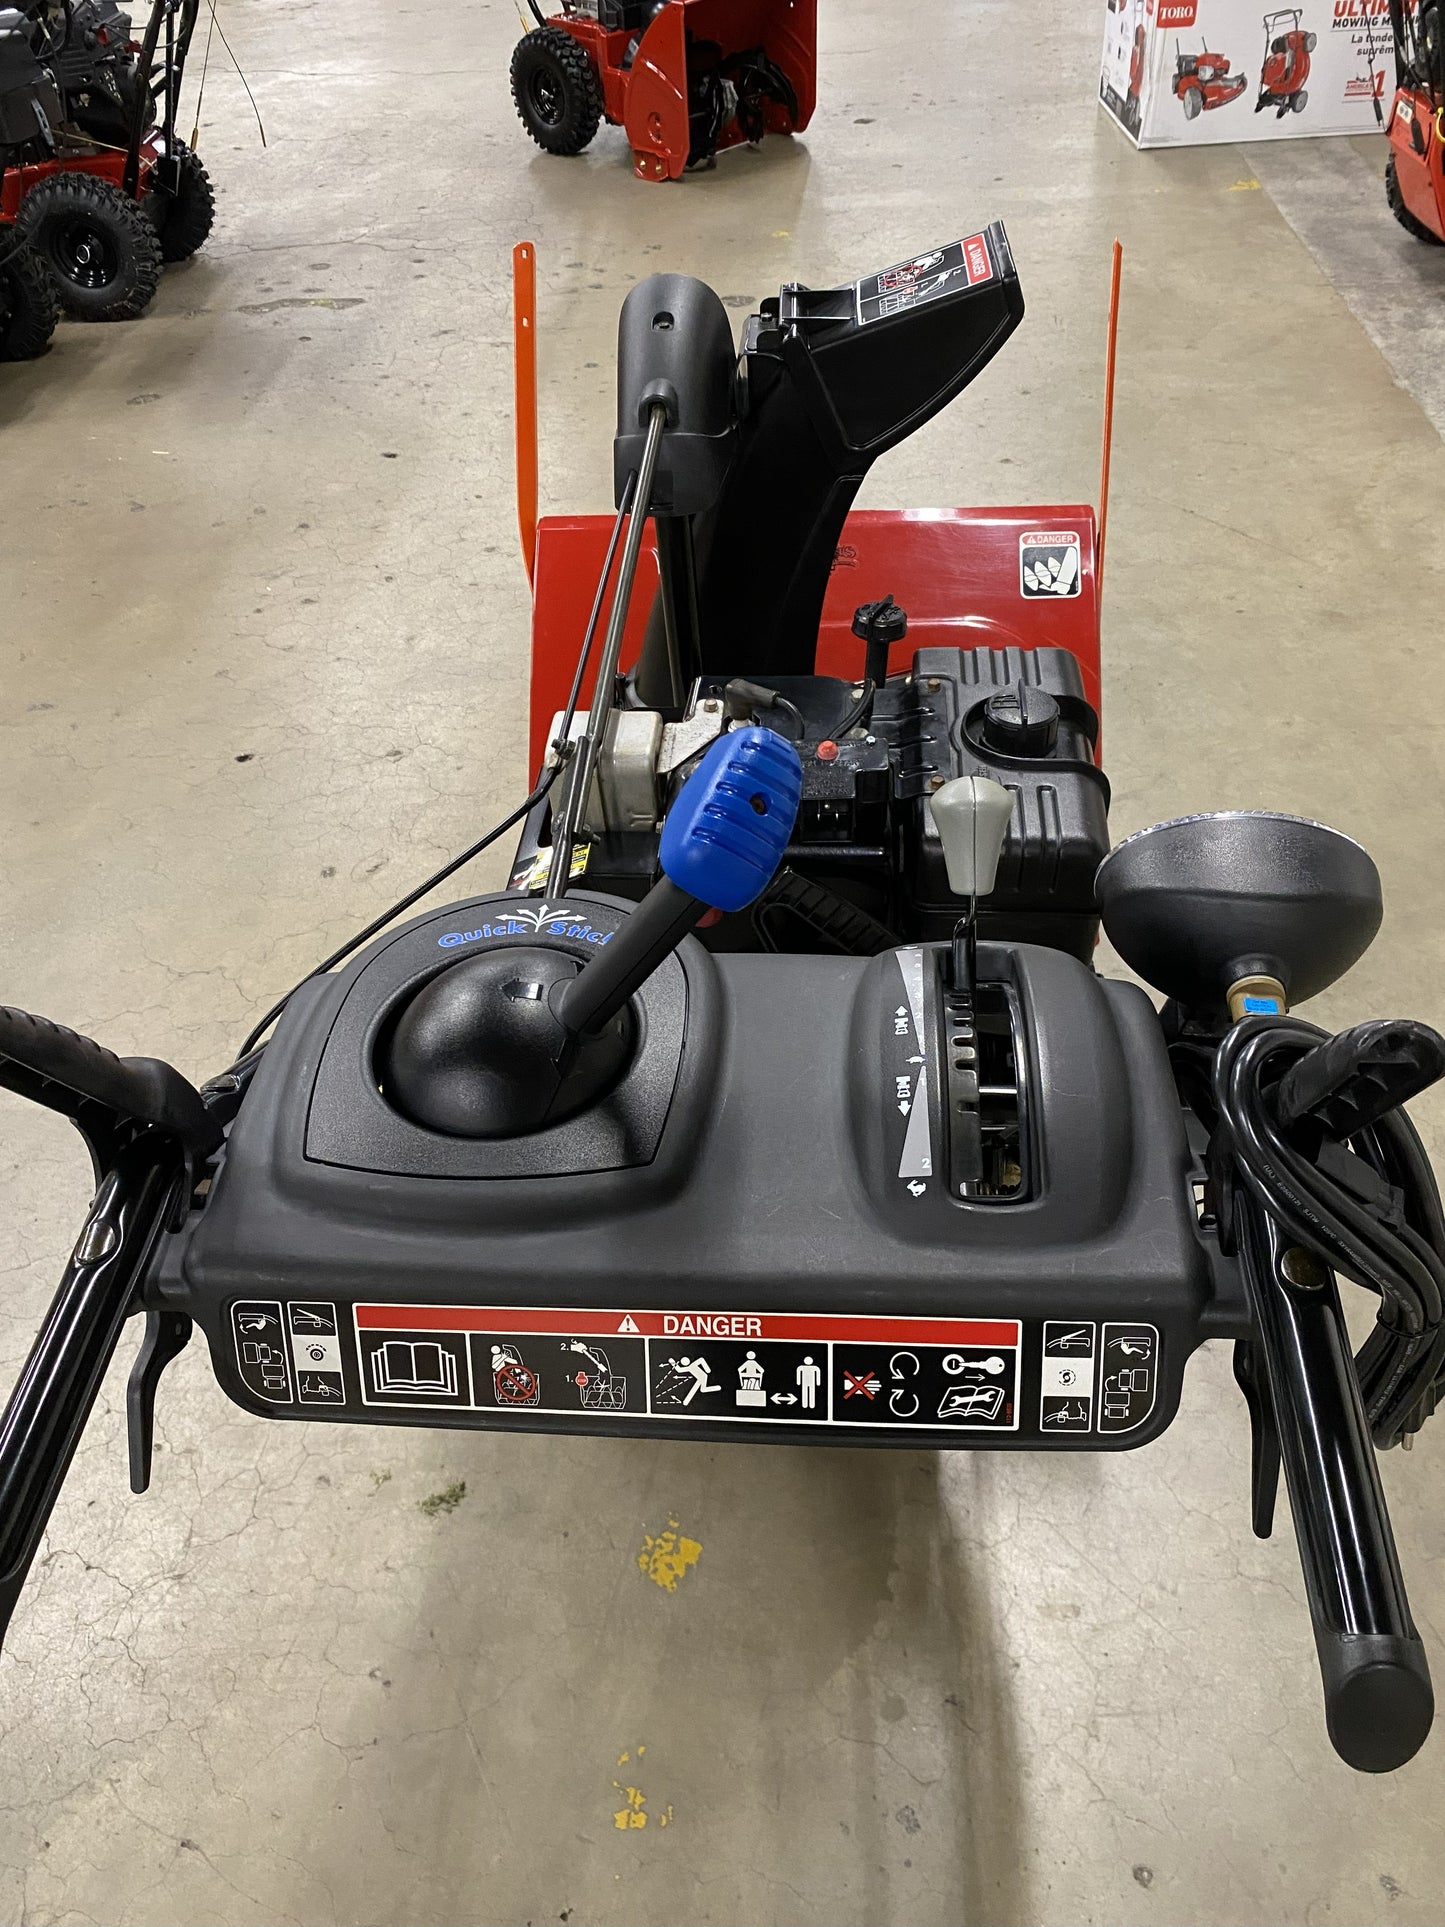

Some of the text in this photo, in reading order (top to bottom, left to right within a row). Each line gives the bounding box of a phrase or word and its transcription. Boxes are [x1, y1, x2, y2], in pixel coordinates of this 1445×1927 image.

[1160, 6, 1194, 20] TORO
[1332, 17, 1379, 28] MOWING
[1351, 34, 1363, 43] La
[1357, 46, 1394, 57] suprêm
[969, 248, 986, 277] DANGER
[1036, 535, 1074, 544] DANGER
[437, 921, 528, 948] Quick
[921, 1157, 930, 1169] 2
[663, 1315, 762, 1336] DANGER
[560, 1343, 569, 1351] 2.
[565, 1374, 574, 1383] 1.
